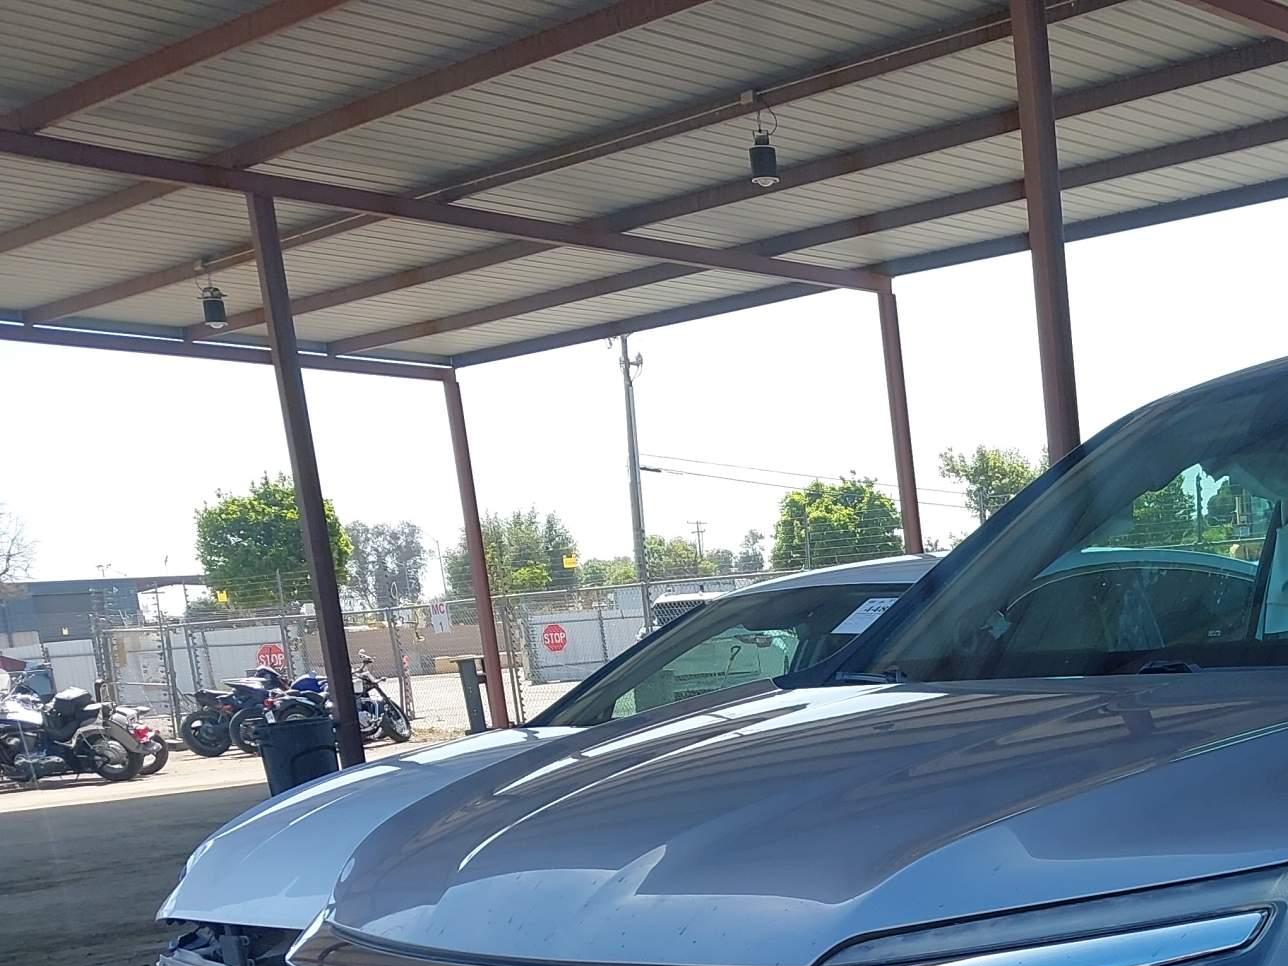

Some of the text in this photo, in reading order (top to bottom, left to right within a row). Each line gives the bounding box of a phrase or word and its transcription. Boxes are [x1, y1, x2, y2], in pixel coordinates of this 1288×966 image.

[432, 603, 445, 615] MC
[543, 632, 566, 645] STOP
[258, 653, 285, 666] STOP
